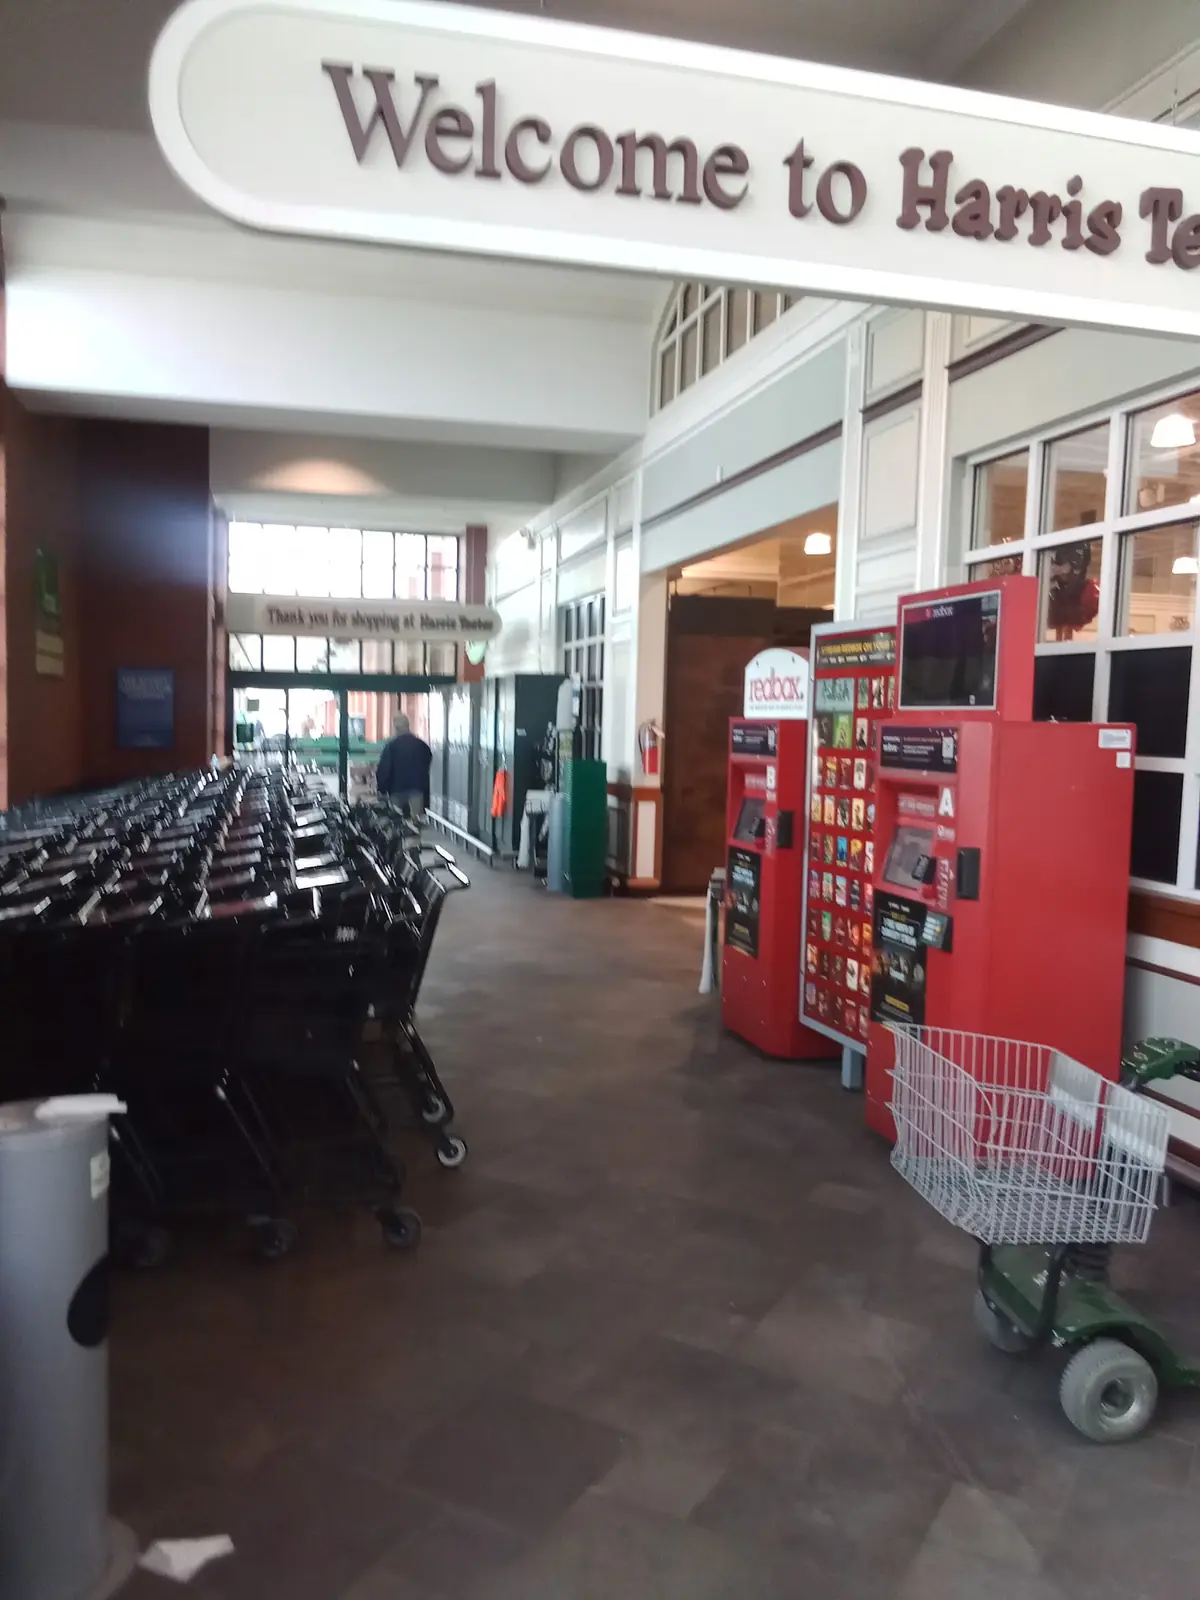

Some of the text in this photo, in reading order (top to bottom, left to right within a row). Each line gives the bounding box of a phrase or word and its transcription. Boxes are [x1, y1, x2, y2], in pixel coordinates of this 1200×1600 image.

[321, 57, 750, 212] Welcome
[782, 136, 868, 225] to
[896, 146, 1123, 256] Harris
[267, 607, 306, 626] Thank
[308, 611, 329, 630] you
[332, 608, 347, 627] for
[351, 608, 400, 633] shopping
[403, 612, 416, 630] at
[938, 787, 955, 817] A
